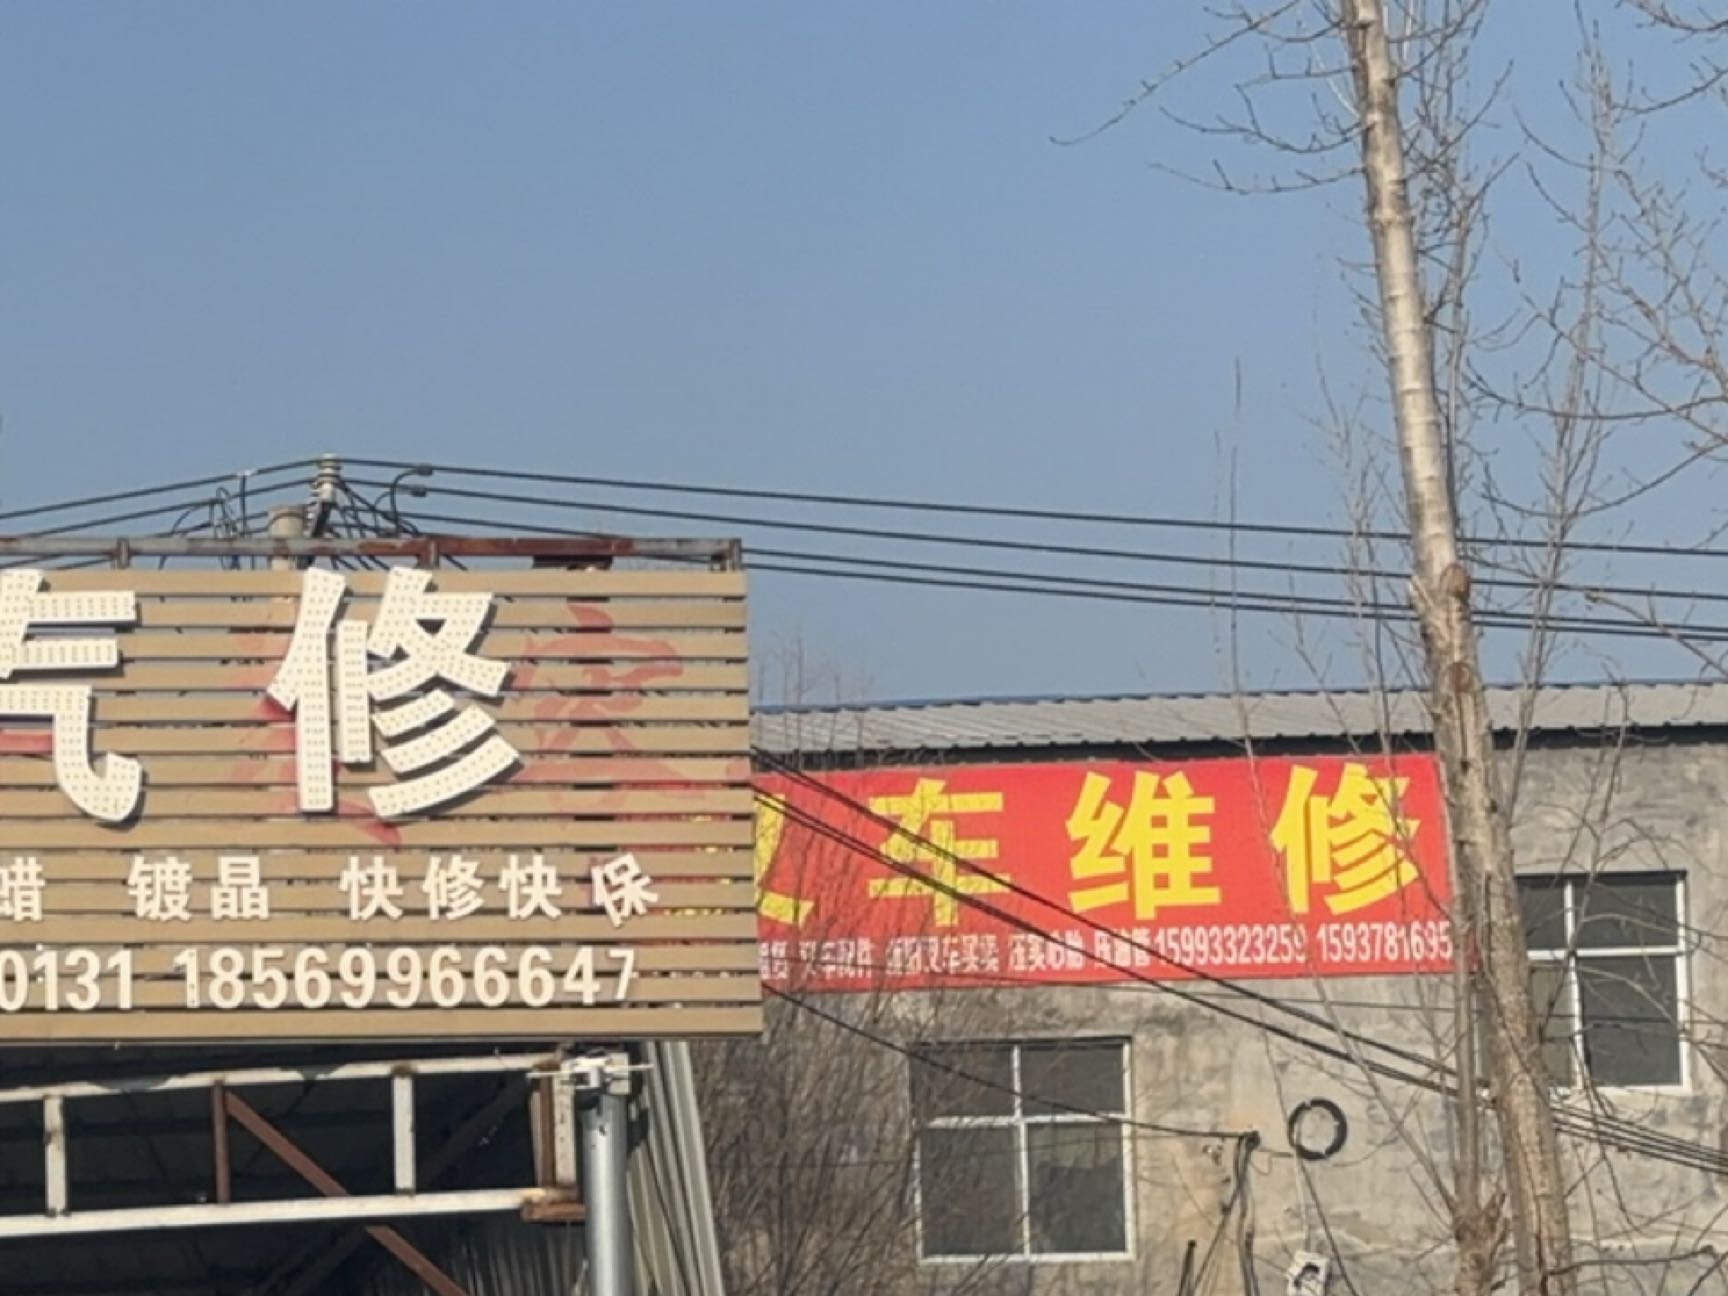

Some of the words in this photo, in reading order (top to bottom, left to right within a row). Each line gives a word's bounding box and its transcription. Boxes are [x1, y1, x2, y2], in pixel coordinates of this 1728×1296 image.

[127, 854, 270, 922] 镀晶
[339, 851, 659, 928] 快修快保
[1316, 919, 1455, 964] 1593781695
[173, 945, 637, 1012] 18569966647
